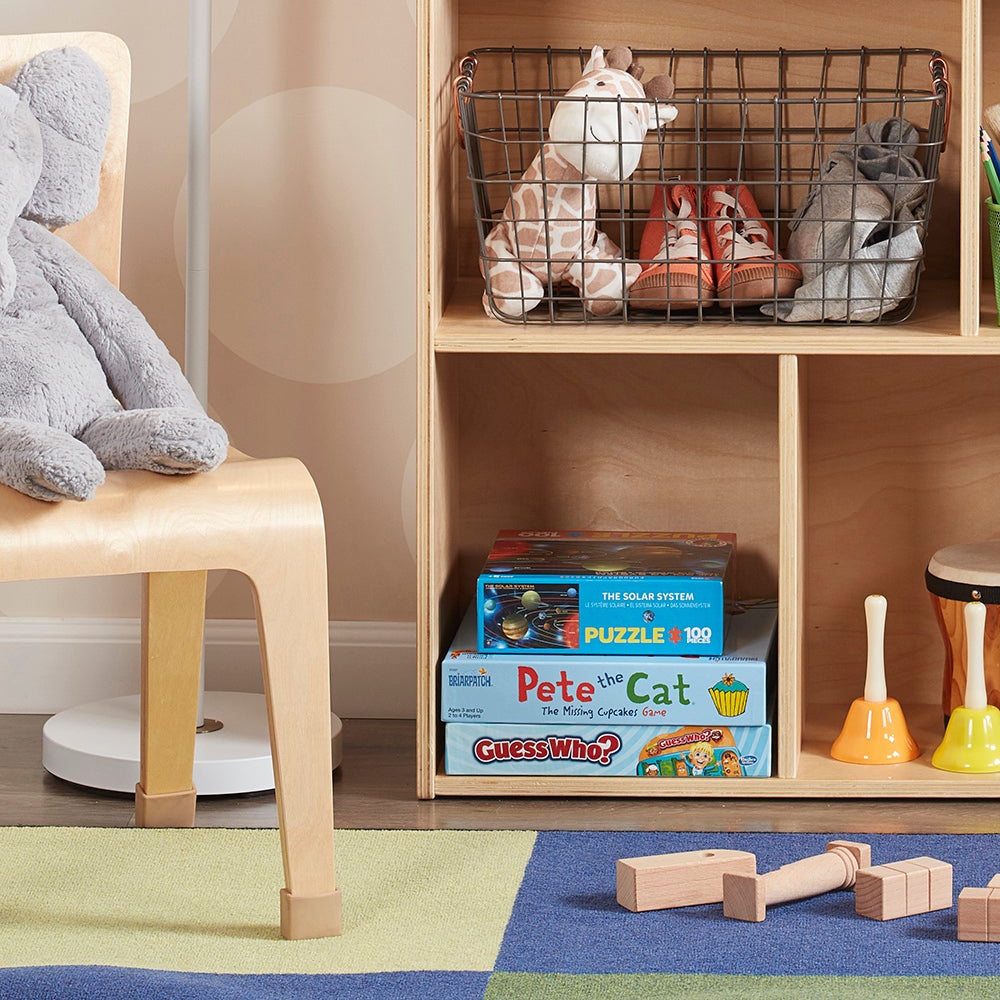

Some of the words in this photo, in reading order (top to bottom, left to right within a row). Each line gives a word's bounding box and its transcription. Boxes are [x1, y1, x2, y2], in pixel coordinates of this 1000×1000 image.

[602, 592, 621, 601] THE
[623, 592, 655, 601] SOLAR
[657, 592, 694, 601] SYSTEM
[584, 627, 665, 644] PUZZLE
[684, 626, 712, 640] 100
[517, 665, 595, 703] Pete
[597, 672, 624, 689] the
[626, 672, 691, 705] Cat
[541, 706, 559, 716] The
[563, 705, 594, 719] Missing
[597, 707, 638, 719] Cupcakes
[642, 707, 667, 717] Game
[658, 735, 686, 750] Guess
[686, 728, 712, 743] Who?
[474, 738, 549, 763] Guess
[549, 733, 622, 766] Who?
